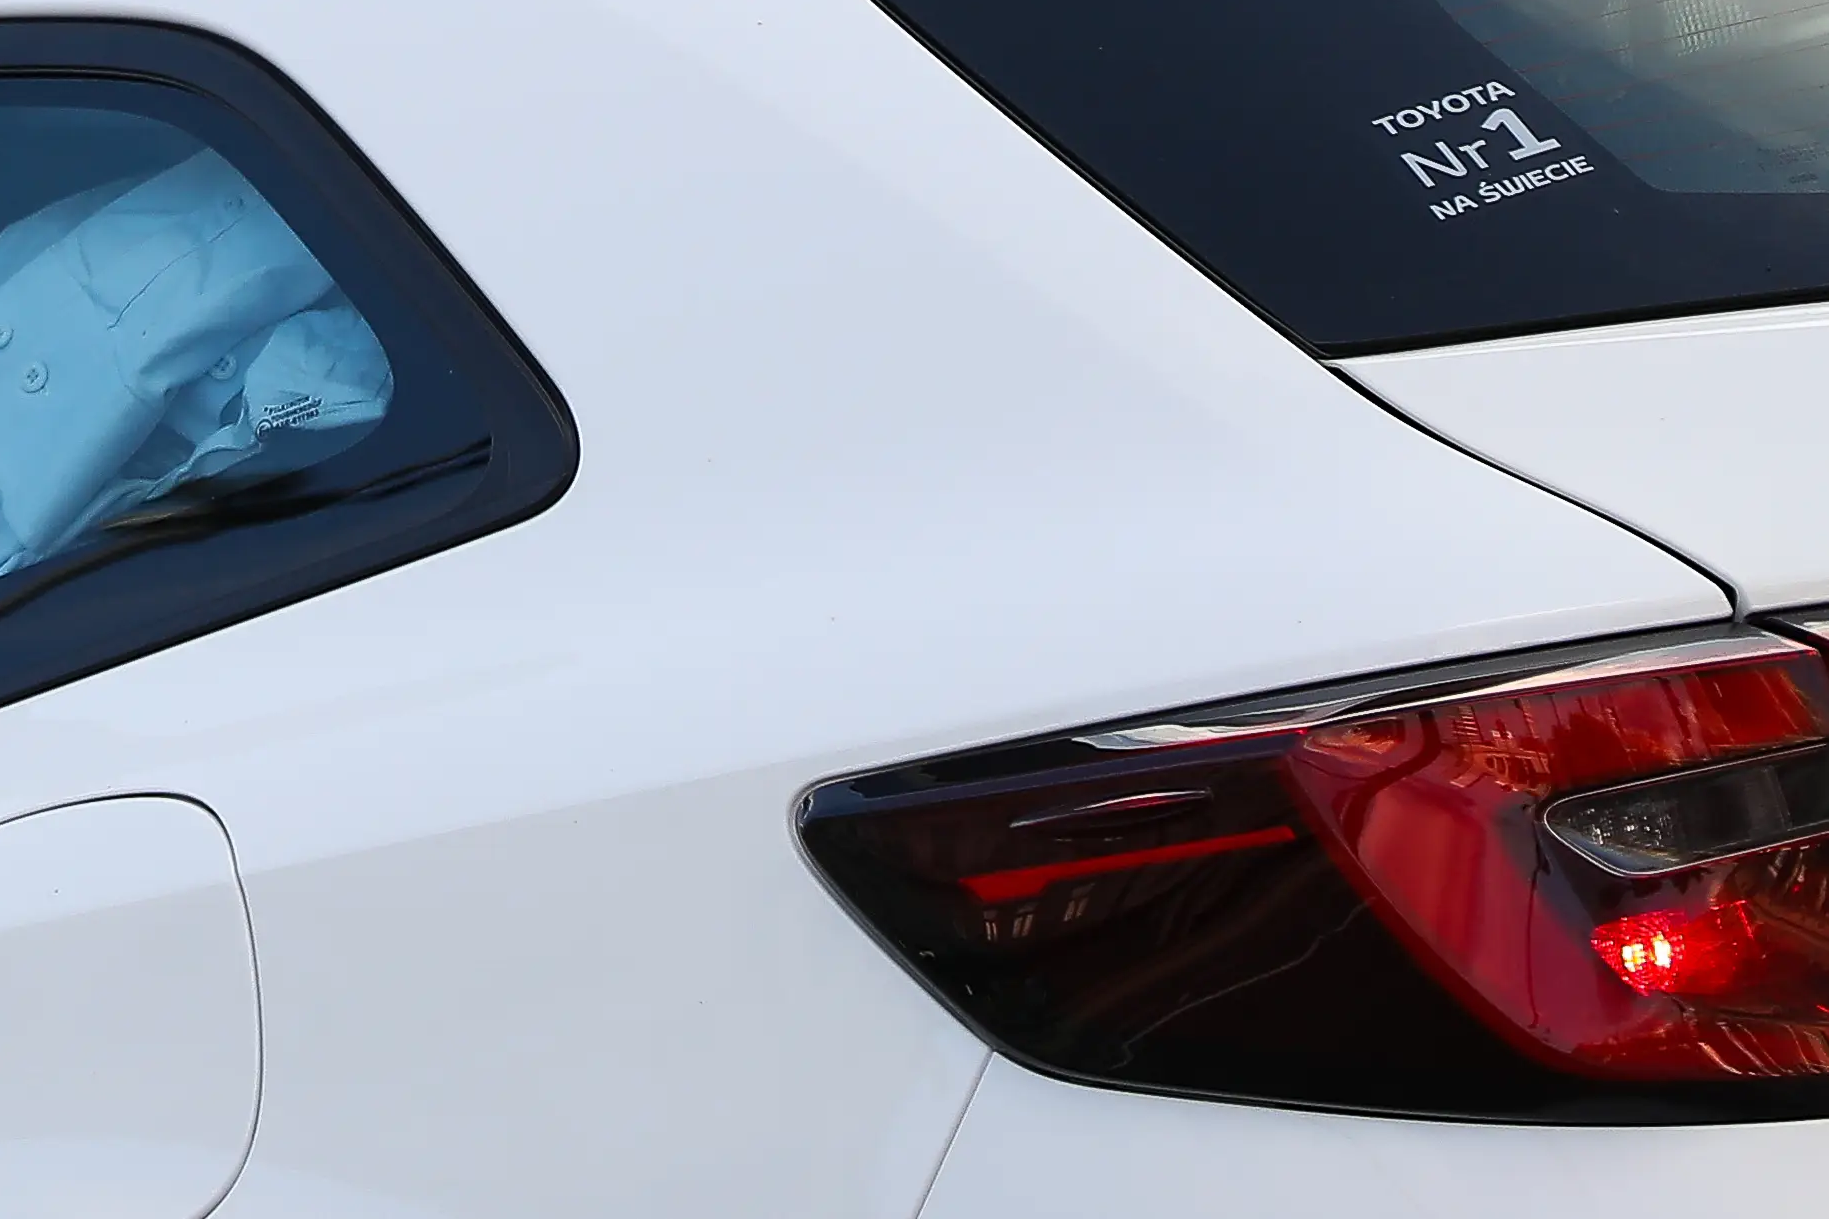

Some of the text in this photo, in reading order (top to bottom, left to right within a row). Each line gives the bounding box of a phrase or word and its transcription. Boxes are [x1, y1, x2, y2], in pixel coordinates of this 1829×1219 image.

[1371, 81, 1516, 135] TOYOTA
[1400, 107, 1562, 188] Nr 1
[1429, 155, 1595, 221] NA ŚWIECIE
